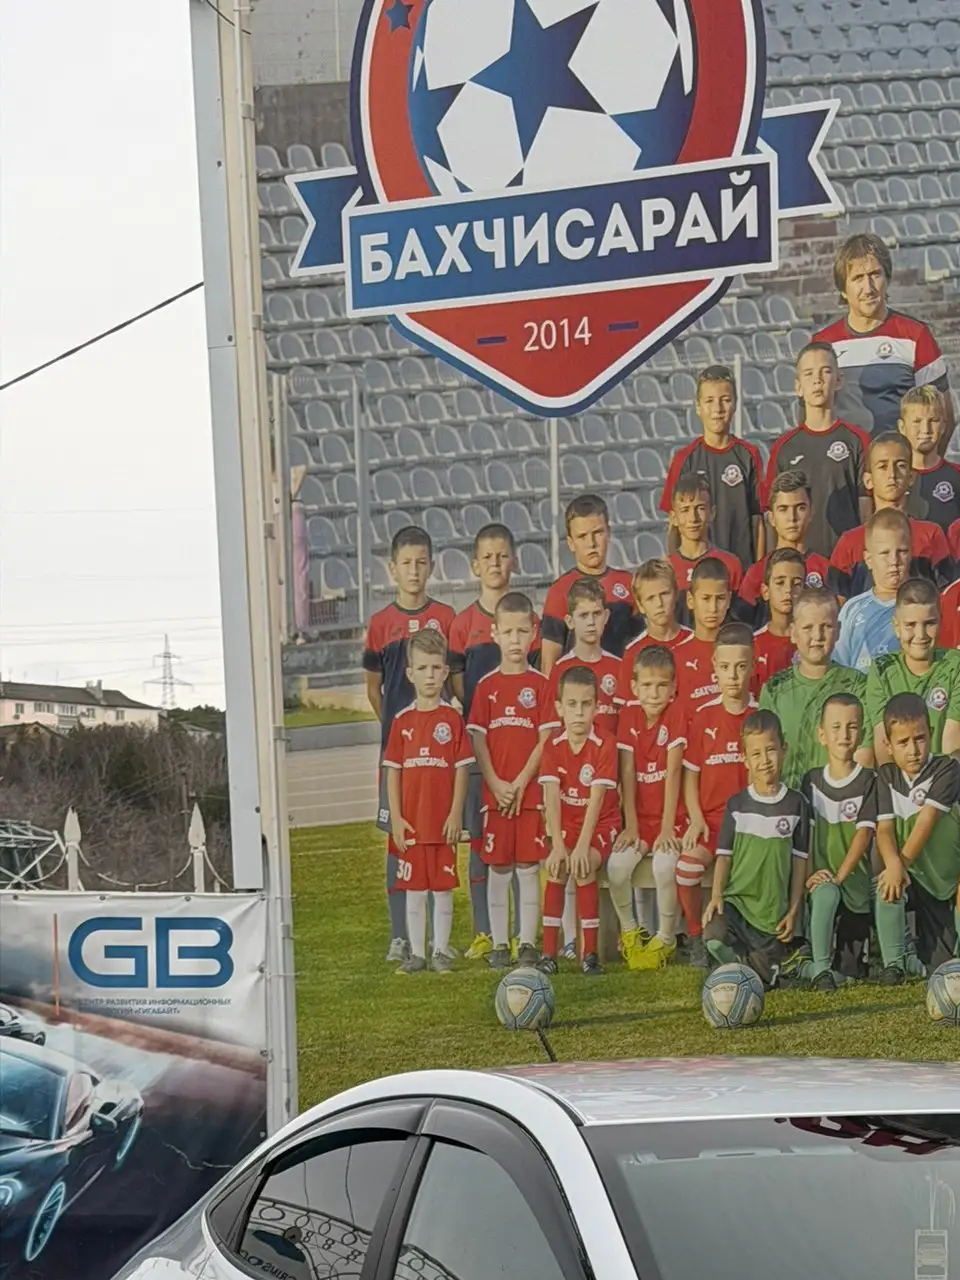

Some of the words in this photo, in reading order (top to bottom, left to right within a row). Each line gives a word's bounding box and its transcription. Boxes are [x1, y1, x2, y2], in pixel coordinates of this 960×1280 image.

[359, 171, 759, 285] БАХЧИСАРАЙ
[522, 315, 593, 353] 2014
[485, 833, 496, 854] 3
[396, 858, 413, 882] 30
[68, 916, 235, 989] GB
